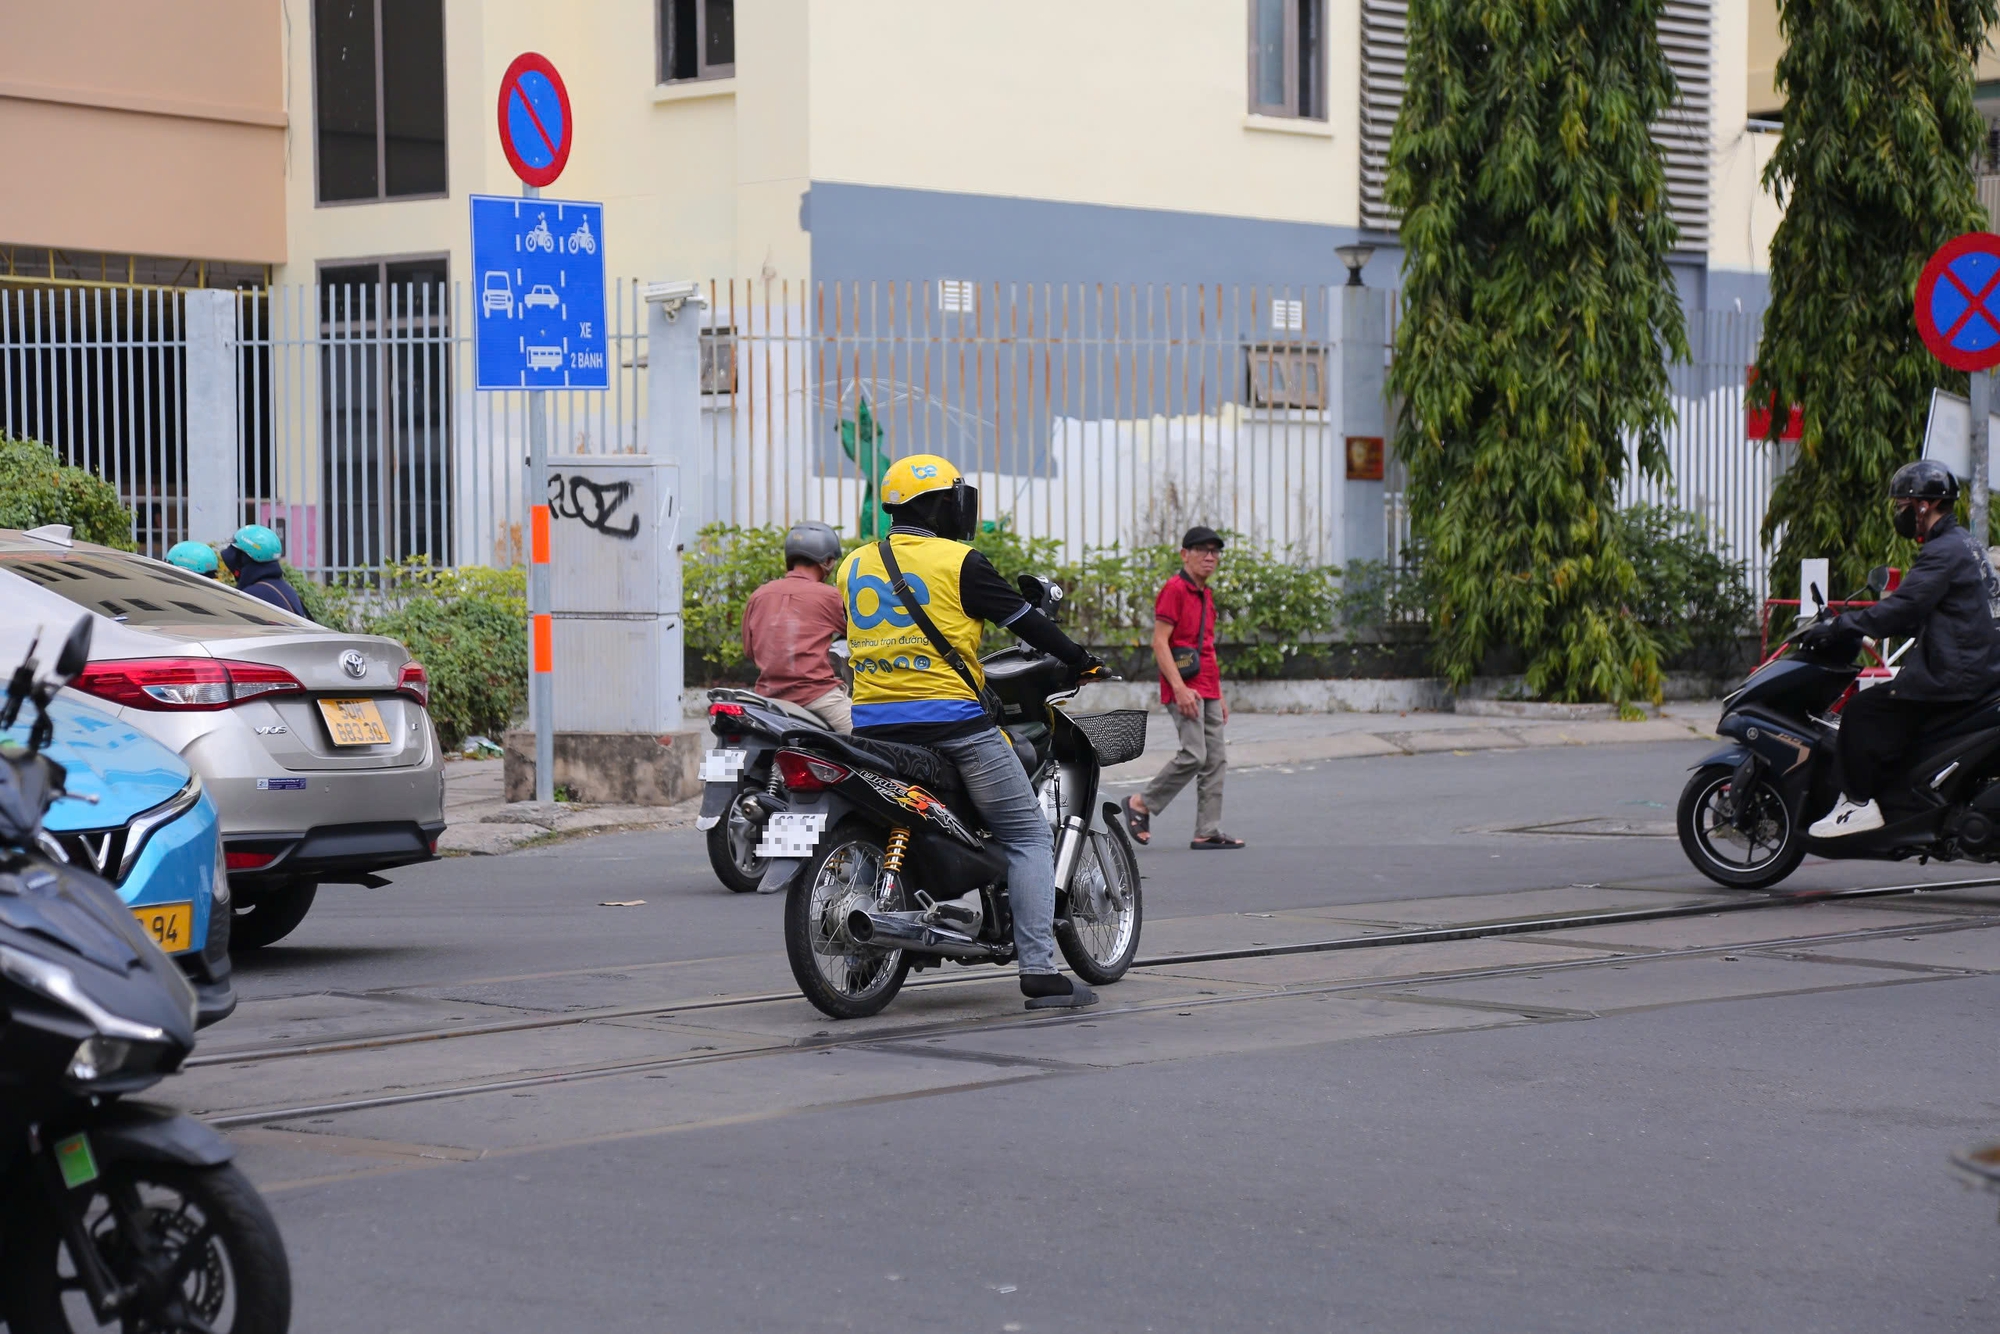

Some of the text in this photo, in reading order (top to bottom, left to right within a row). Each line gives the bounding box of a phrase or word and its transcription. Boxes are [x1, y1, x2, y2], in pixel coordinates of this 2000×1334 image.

[579, 321, 592, 339] XE
[570, 347, 604, 369] 2 BÁNH
[911, 464, 938, 480] be
[847, 557, 930, 630] be
[861, 638, 879, 648] nhau
[880, 637, 897, 648] trọn
[898, 634, 930, 646] đường
